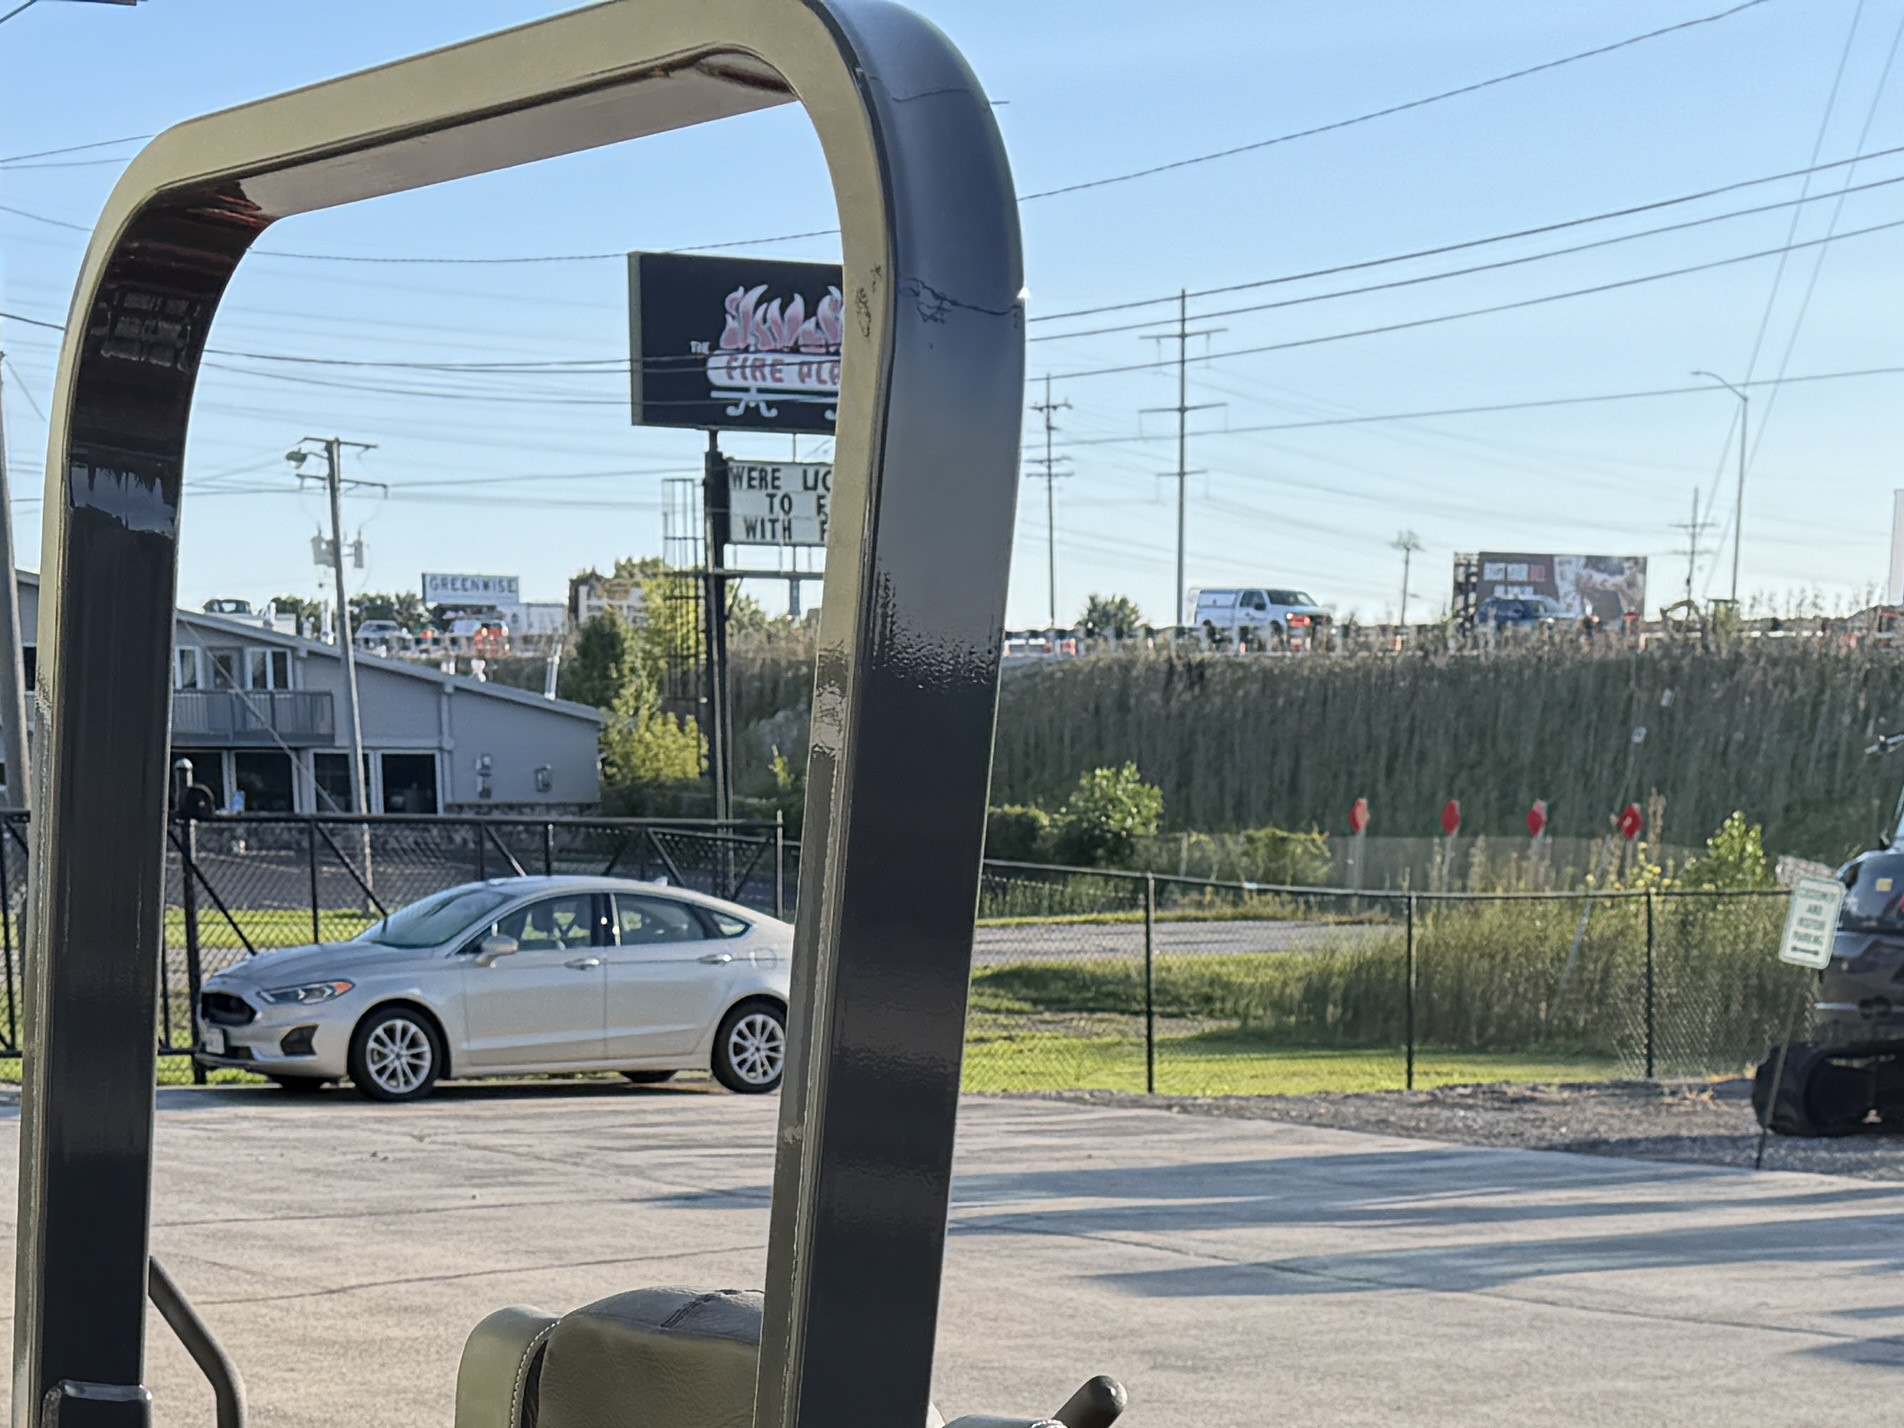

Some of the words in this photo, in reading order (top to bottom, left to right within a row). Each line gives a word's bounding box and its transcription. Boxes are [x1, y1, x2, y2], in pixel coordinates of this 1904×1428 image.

[726, 356, 785, 383] FIRE
[766, 493, 792, 515] TO
[744, 516, 792, 540] WITH
